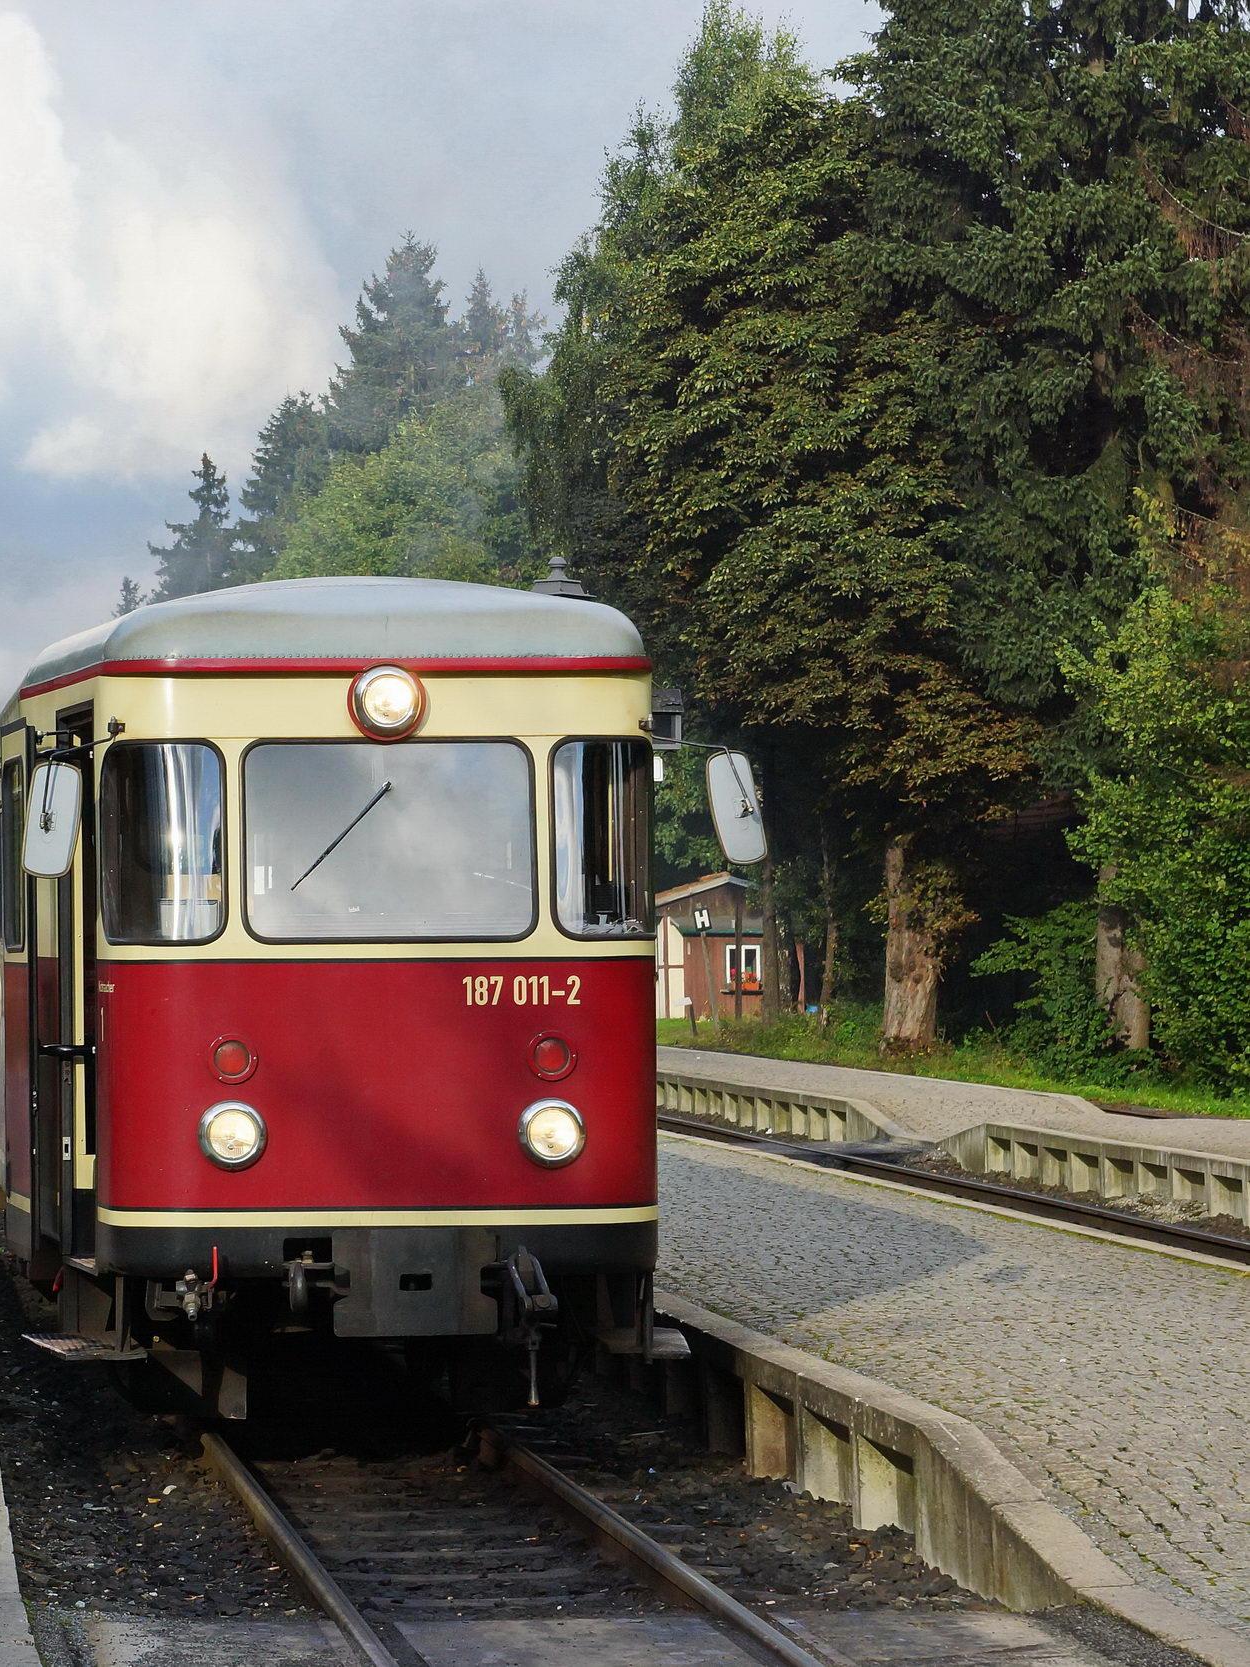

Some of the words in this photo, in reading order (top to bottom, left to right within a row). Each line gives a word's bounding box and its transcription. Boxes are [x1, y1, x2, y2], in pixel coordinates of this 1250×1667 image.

[694, 909, 710, 929] H
[462, 976, 504, 1005] 187
[513, 975, 581, 1005] 011-2
